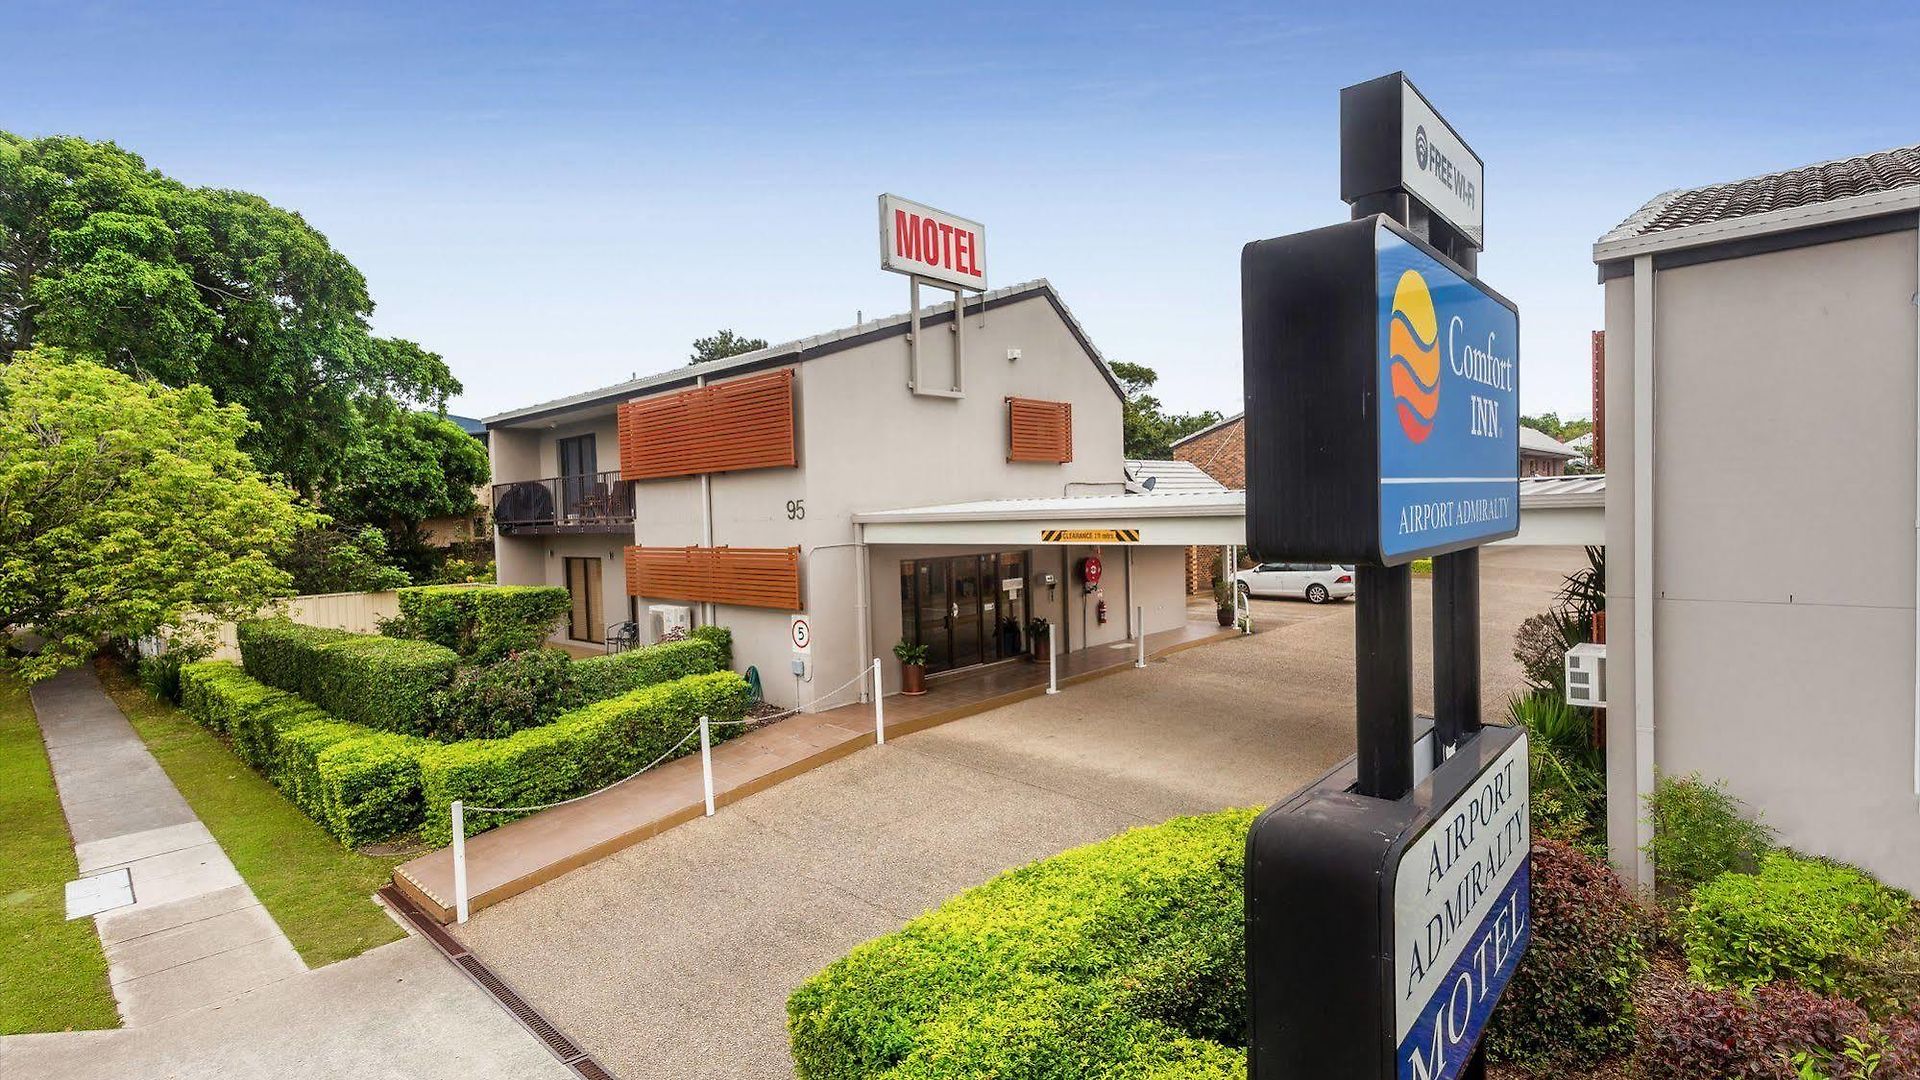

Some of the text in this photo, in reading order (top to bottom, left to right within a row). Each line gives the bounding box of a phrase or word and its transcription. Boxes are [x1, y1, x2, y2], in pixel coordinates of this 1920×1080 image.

[1429, 142, 1475, 211] FREE WI-FI
[895, 208, 982, 278] MOTEL
[1449, 316, 1513, 392] Comfort
[1471, 395, 1499, 438] INN
[786, 499, 806, 521] 95
[1062, 531, 1093, 540] CLEARANCE
[1399, 497, 1510, 535] AIRPORT ADMIRALTY
[797, 626, 805, 641] 5
[1426, 759, 1515, 896] AIRPORT
[1406, 803, 1525, 1000] ADMIRALTY
[1408, 889, 1525, 1080] MOTEL
